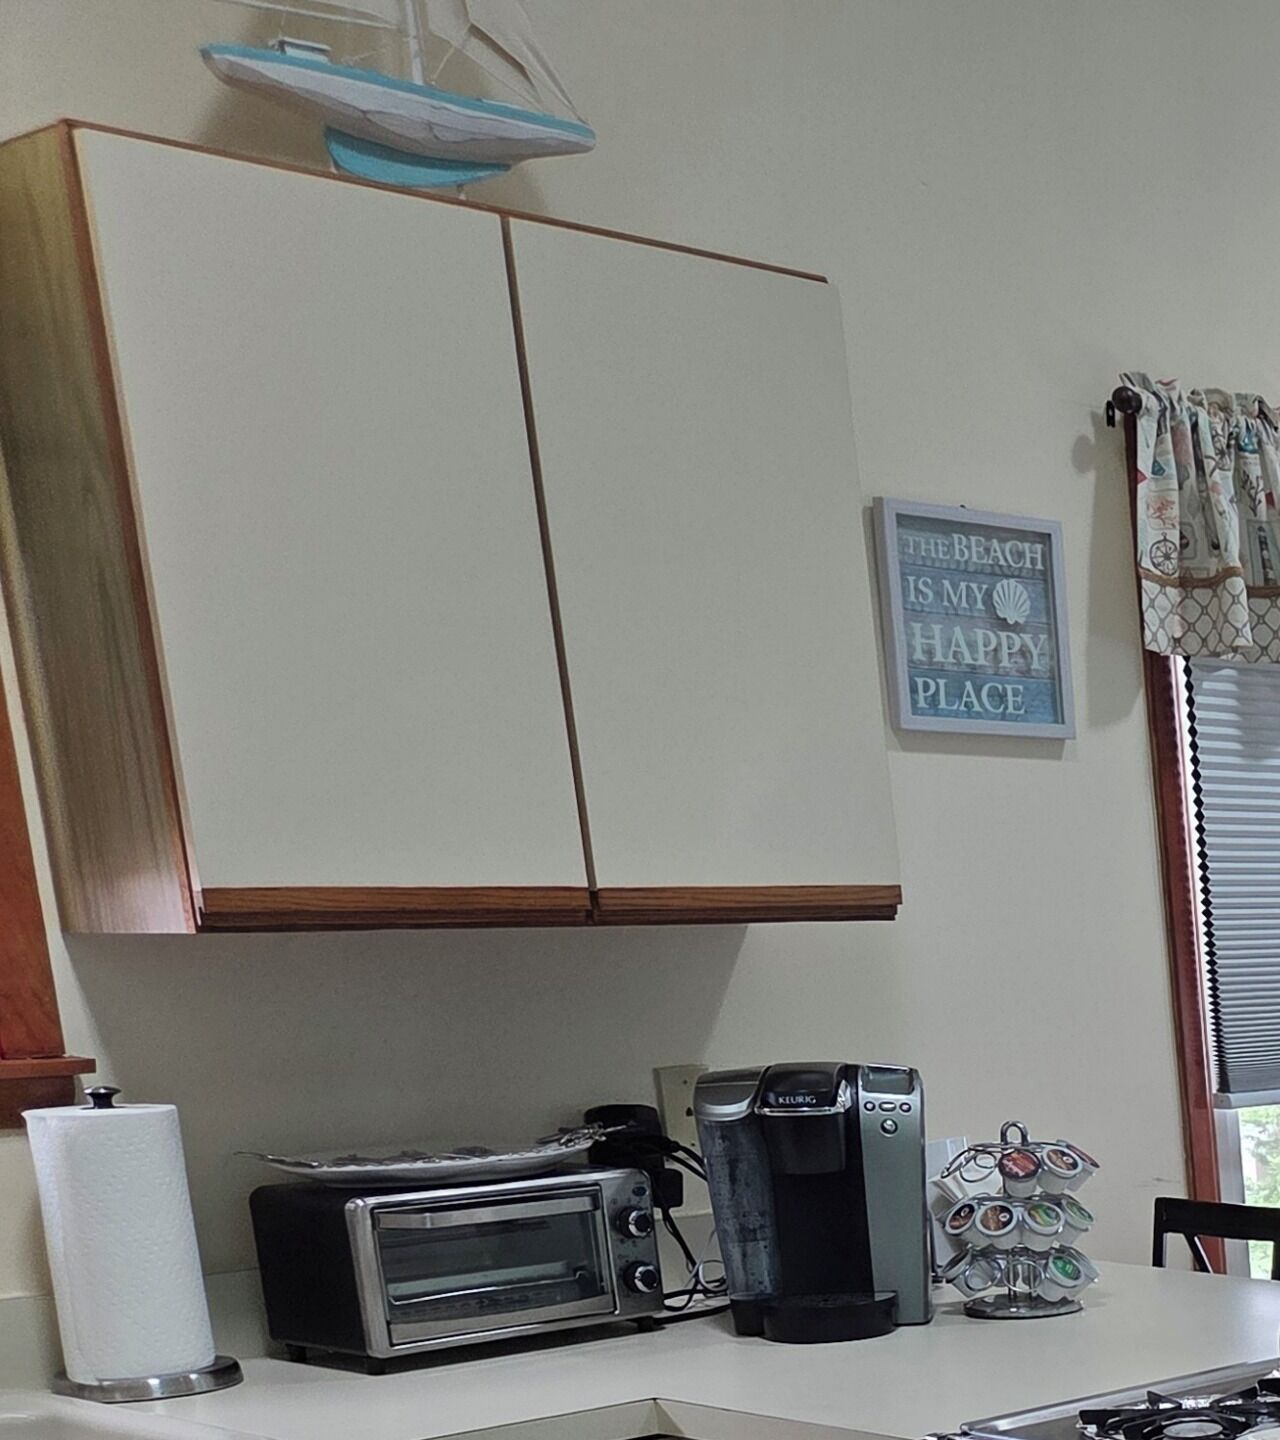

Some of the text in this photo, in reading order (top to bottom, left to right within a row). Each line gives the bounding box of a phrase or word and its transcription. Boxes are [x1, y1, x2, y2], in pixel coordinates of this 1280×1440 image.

[903, 532, 1045, 570] THE BEACH
[905, 575, 989, 610] IS MY
[910, 622, 1048, 670] HAPPY
[914, 676, 1025, 715] PLACE
[778, 1095, 817, 1105] KEURIG
